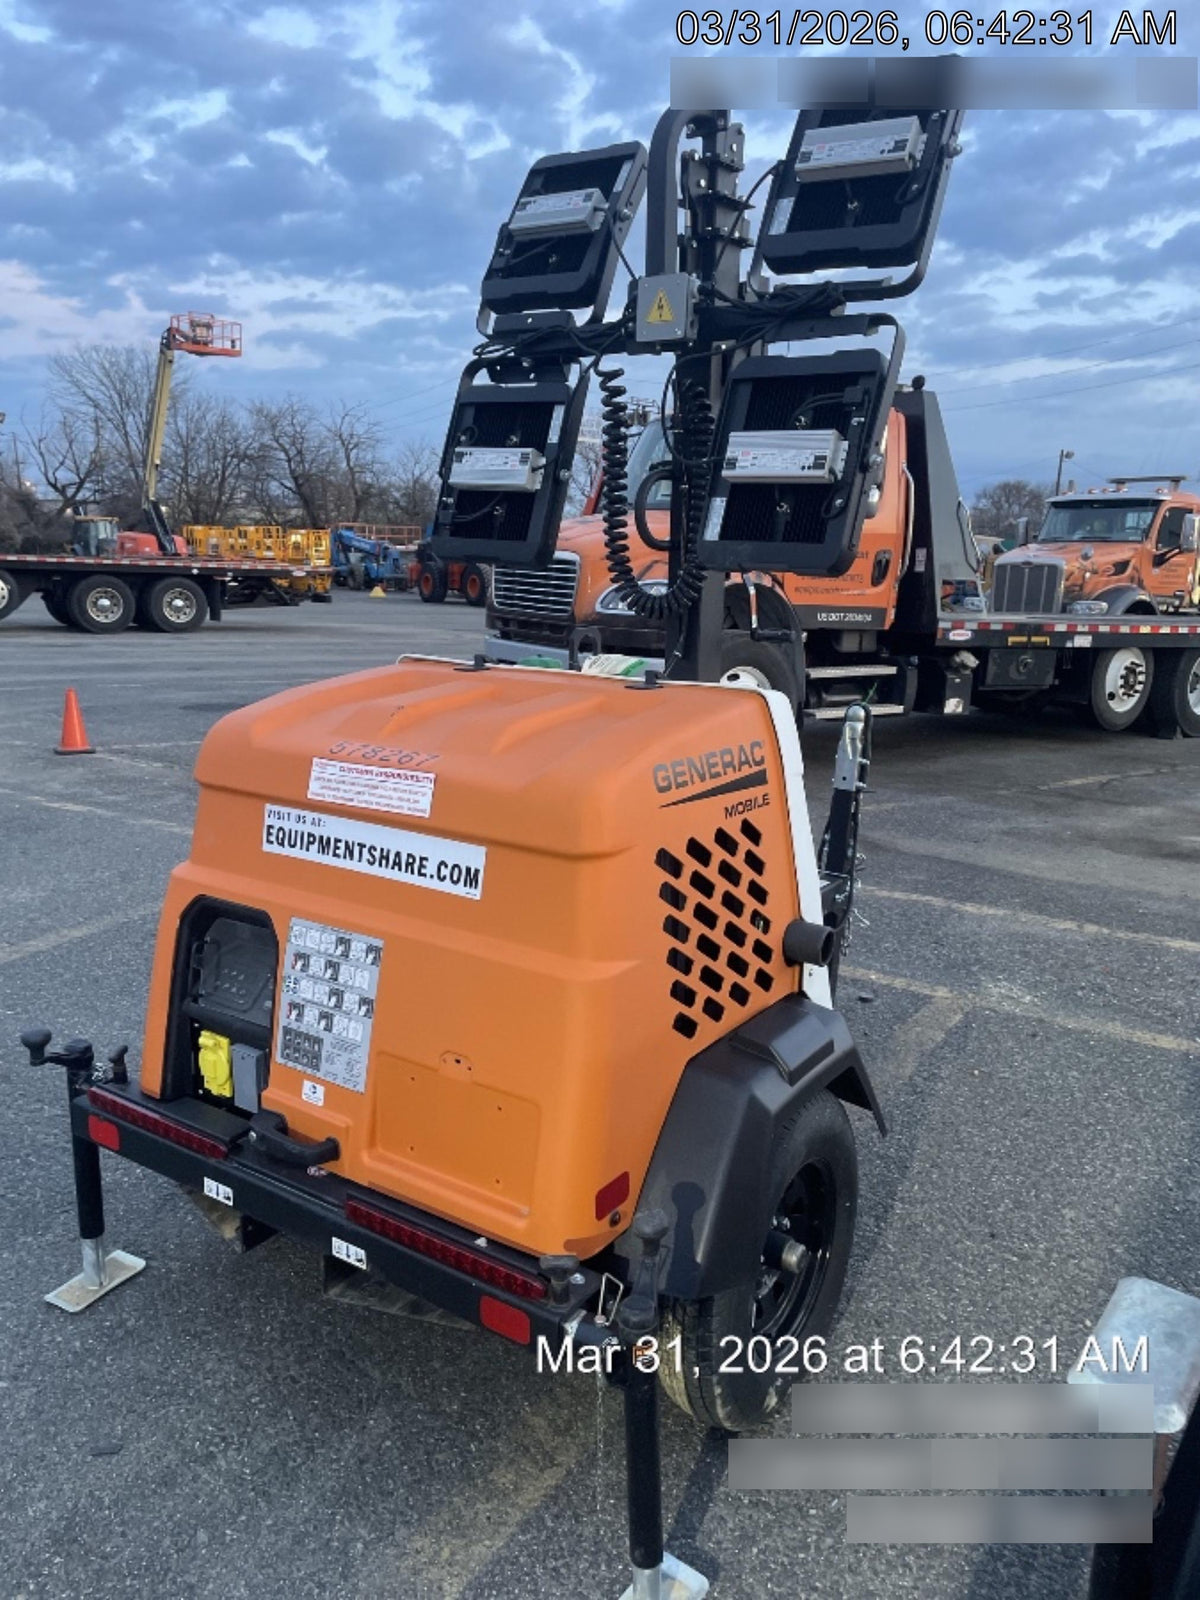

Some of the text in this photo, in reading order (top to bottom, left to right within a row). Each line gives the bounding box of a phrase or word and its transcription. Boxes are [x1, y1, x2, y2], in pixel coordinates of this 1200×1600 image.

[653, 740, 765, 794] GENERAC
[266, 809, 327, 828] VISIT US AT:
[724, 793, 771, 820] MOBILE
[265, 824, 481, 890] EQUIPMENTSHARE.COM
